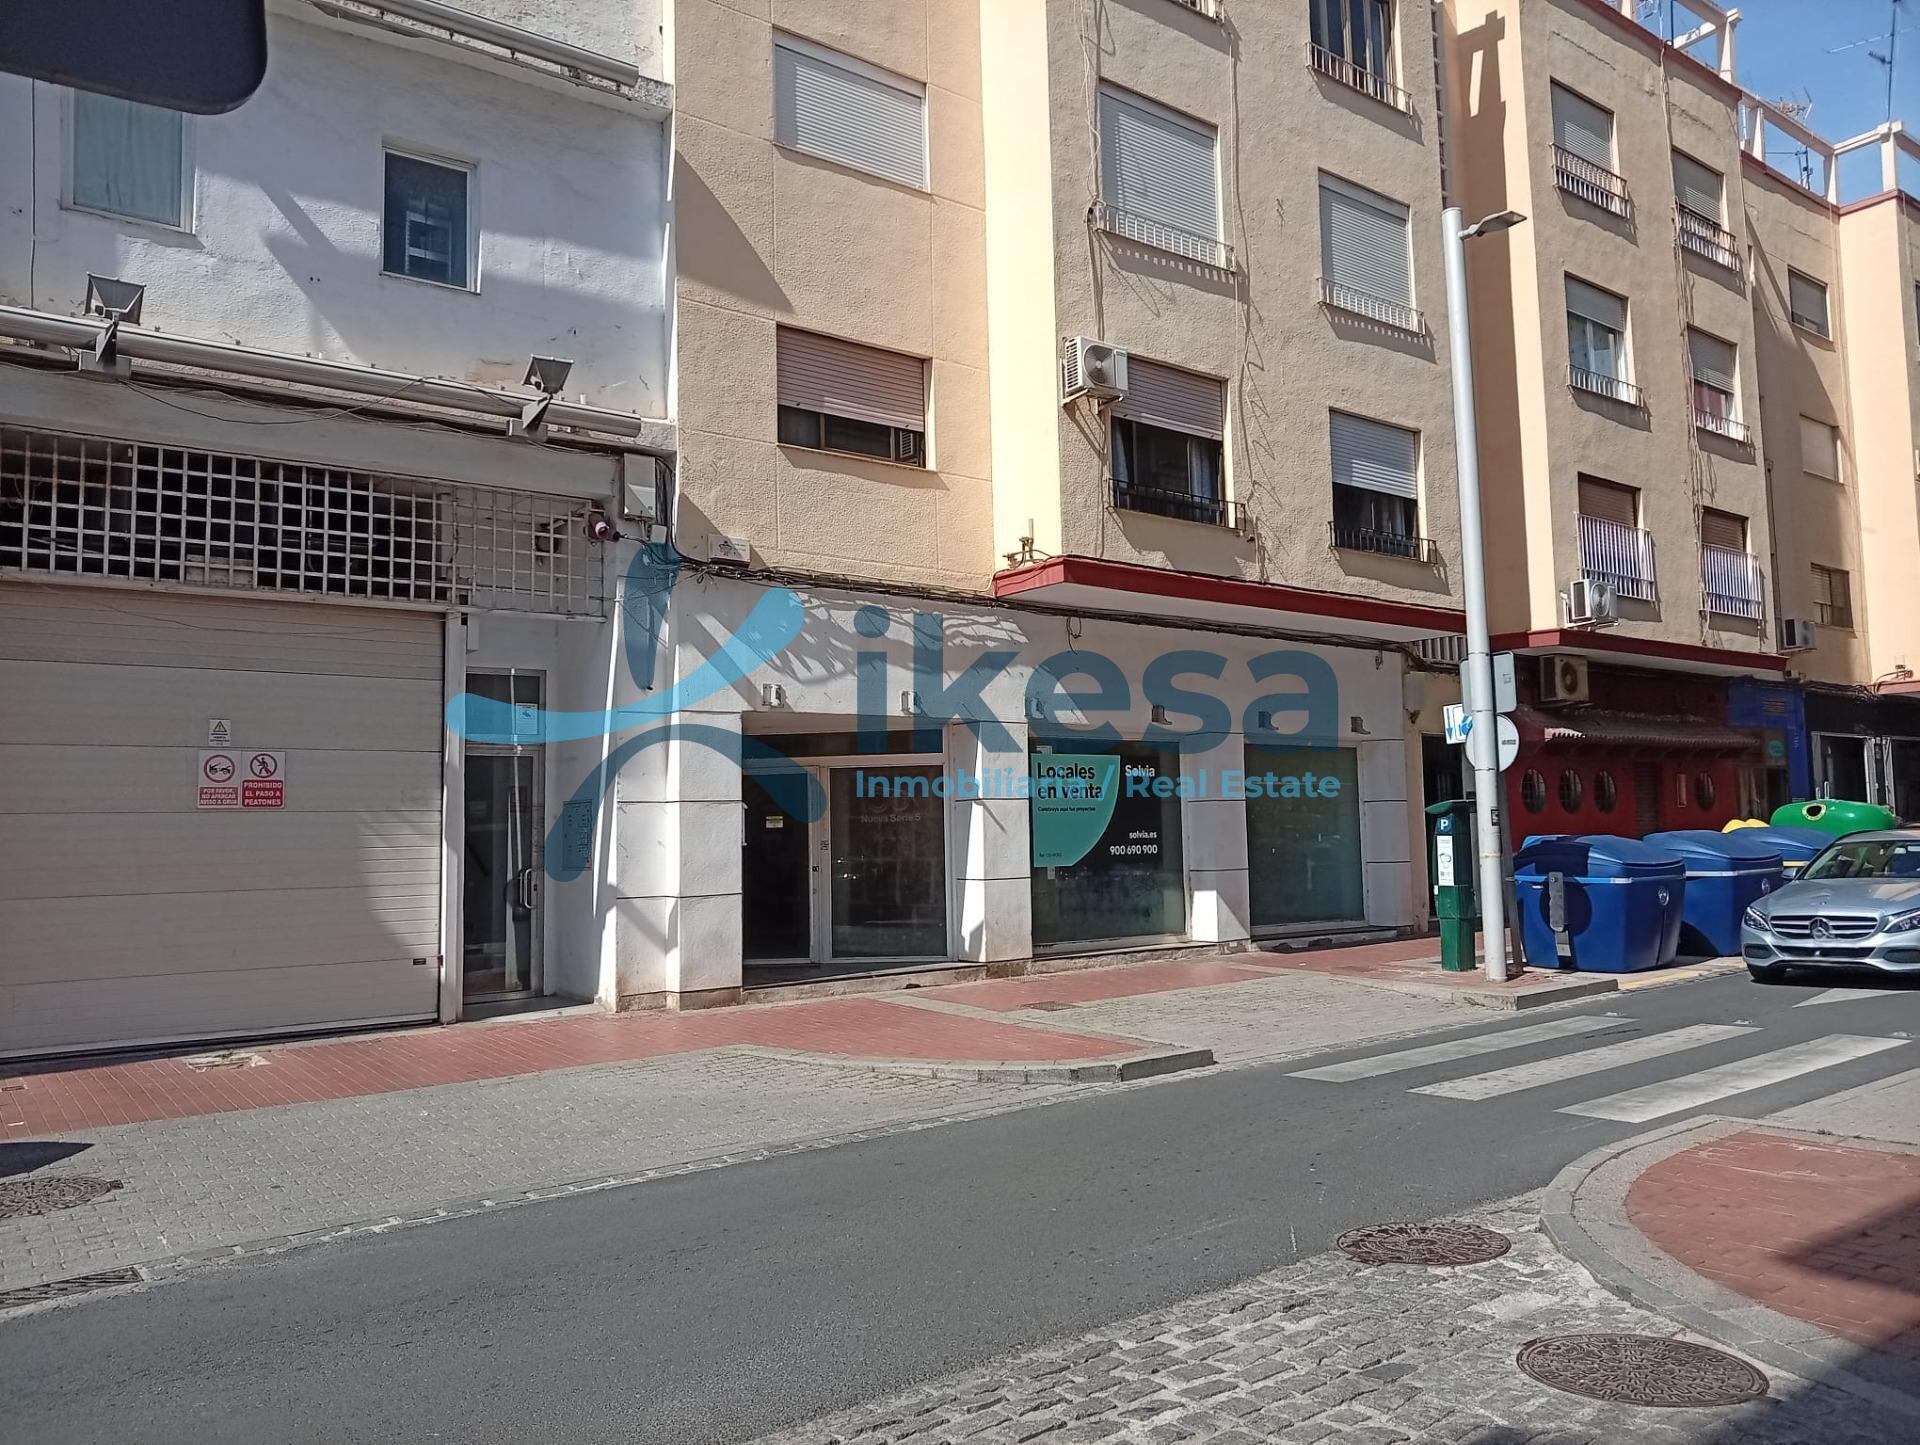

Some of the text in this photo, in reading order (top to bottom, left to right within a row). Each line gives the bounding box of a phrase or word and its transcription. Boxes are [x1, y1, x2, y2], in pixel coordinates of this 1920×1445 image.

[1037, 762, 1096, 780] Locales
[1125, 764, 1155, 777] Solvia
[243, 781, 282, 789] PROHIBIDO
[1037, 782, 1104, 800] en venta
[1440, 819, 1449, 831] P
[1129, 830, 1158, 839] solvia.es
[1109, 844, 1158, 856] 900 690 900
